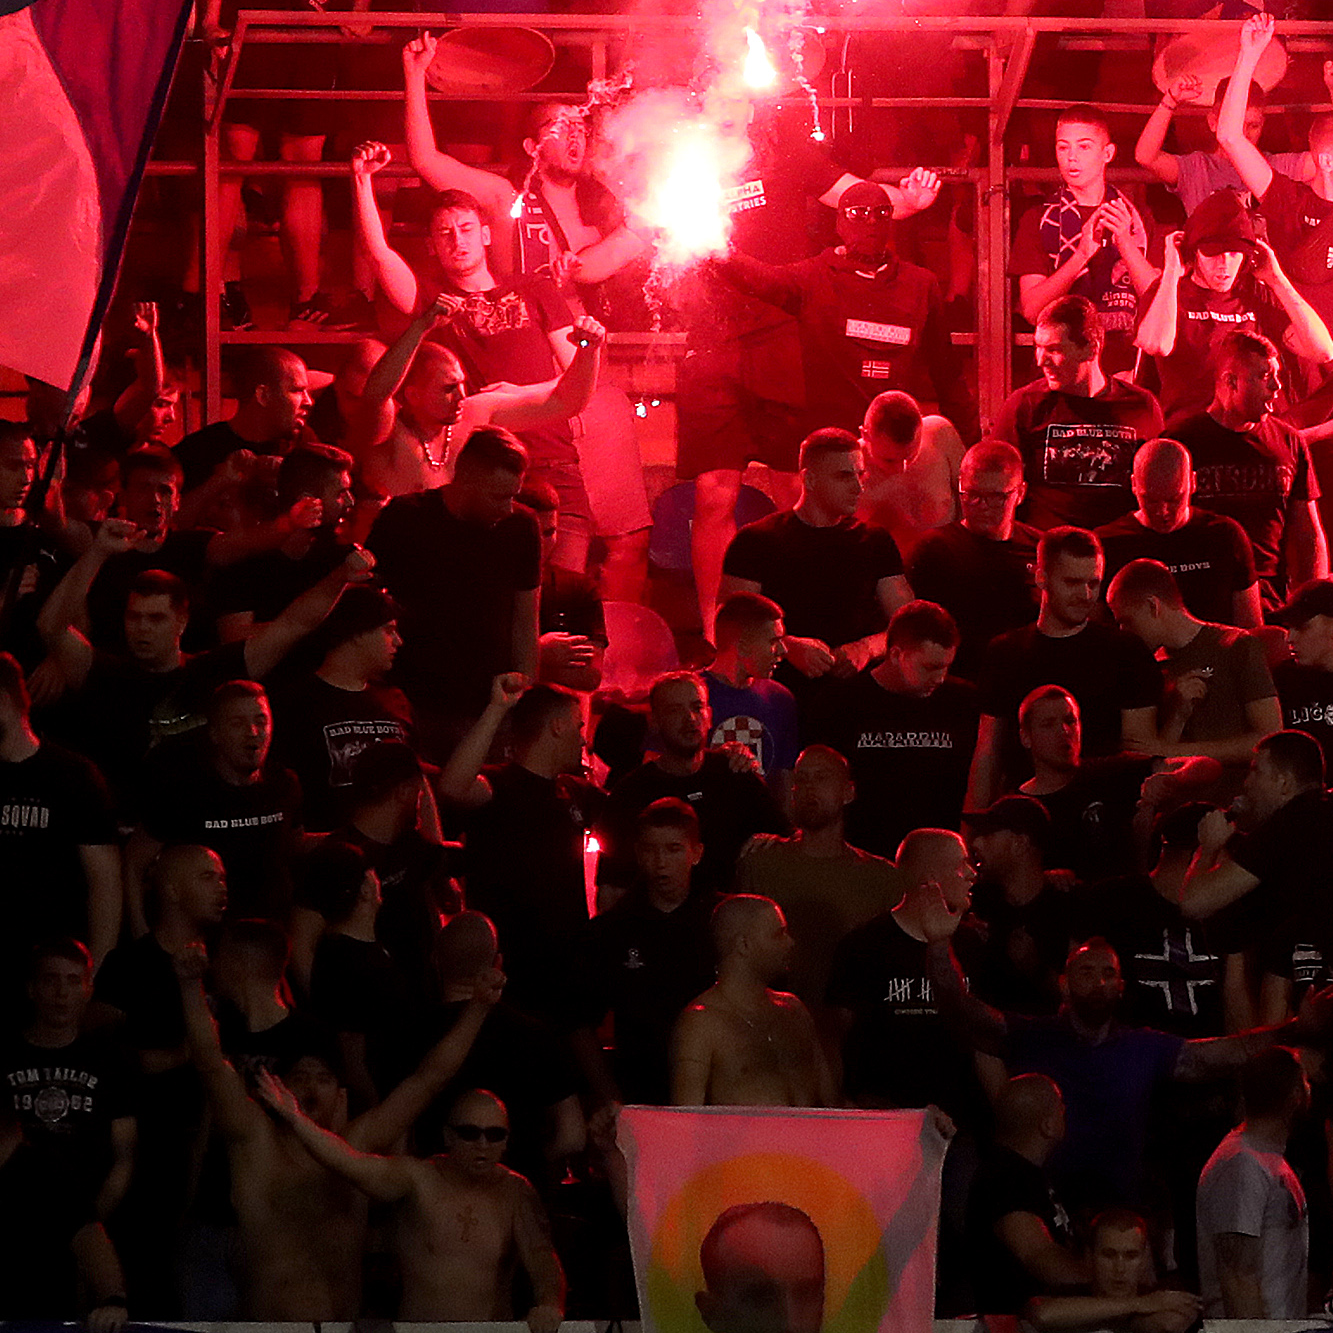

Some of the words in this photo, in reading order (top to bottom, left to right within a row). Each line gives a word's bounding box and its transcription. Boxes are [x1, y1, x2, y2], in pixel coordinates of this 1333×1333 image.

[1051, 427, 1075, 438] BAD
[1076, 427, 1103, 439] BLUE
[231, 817, 260, 829] BLUE
[7, 1069, 40, 1087] TOM
[44, 1067, 100, 1090] TAILOR
